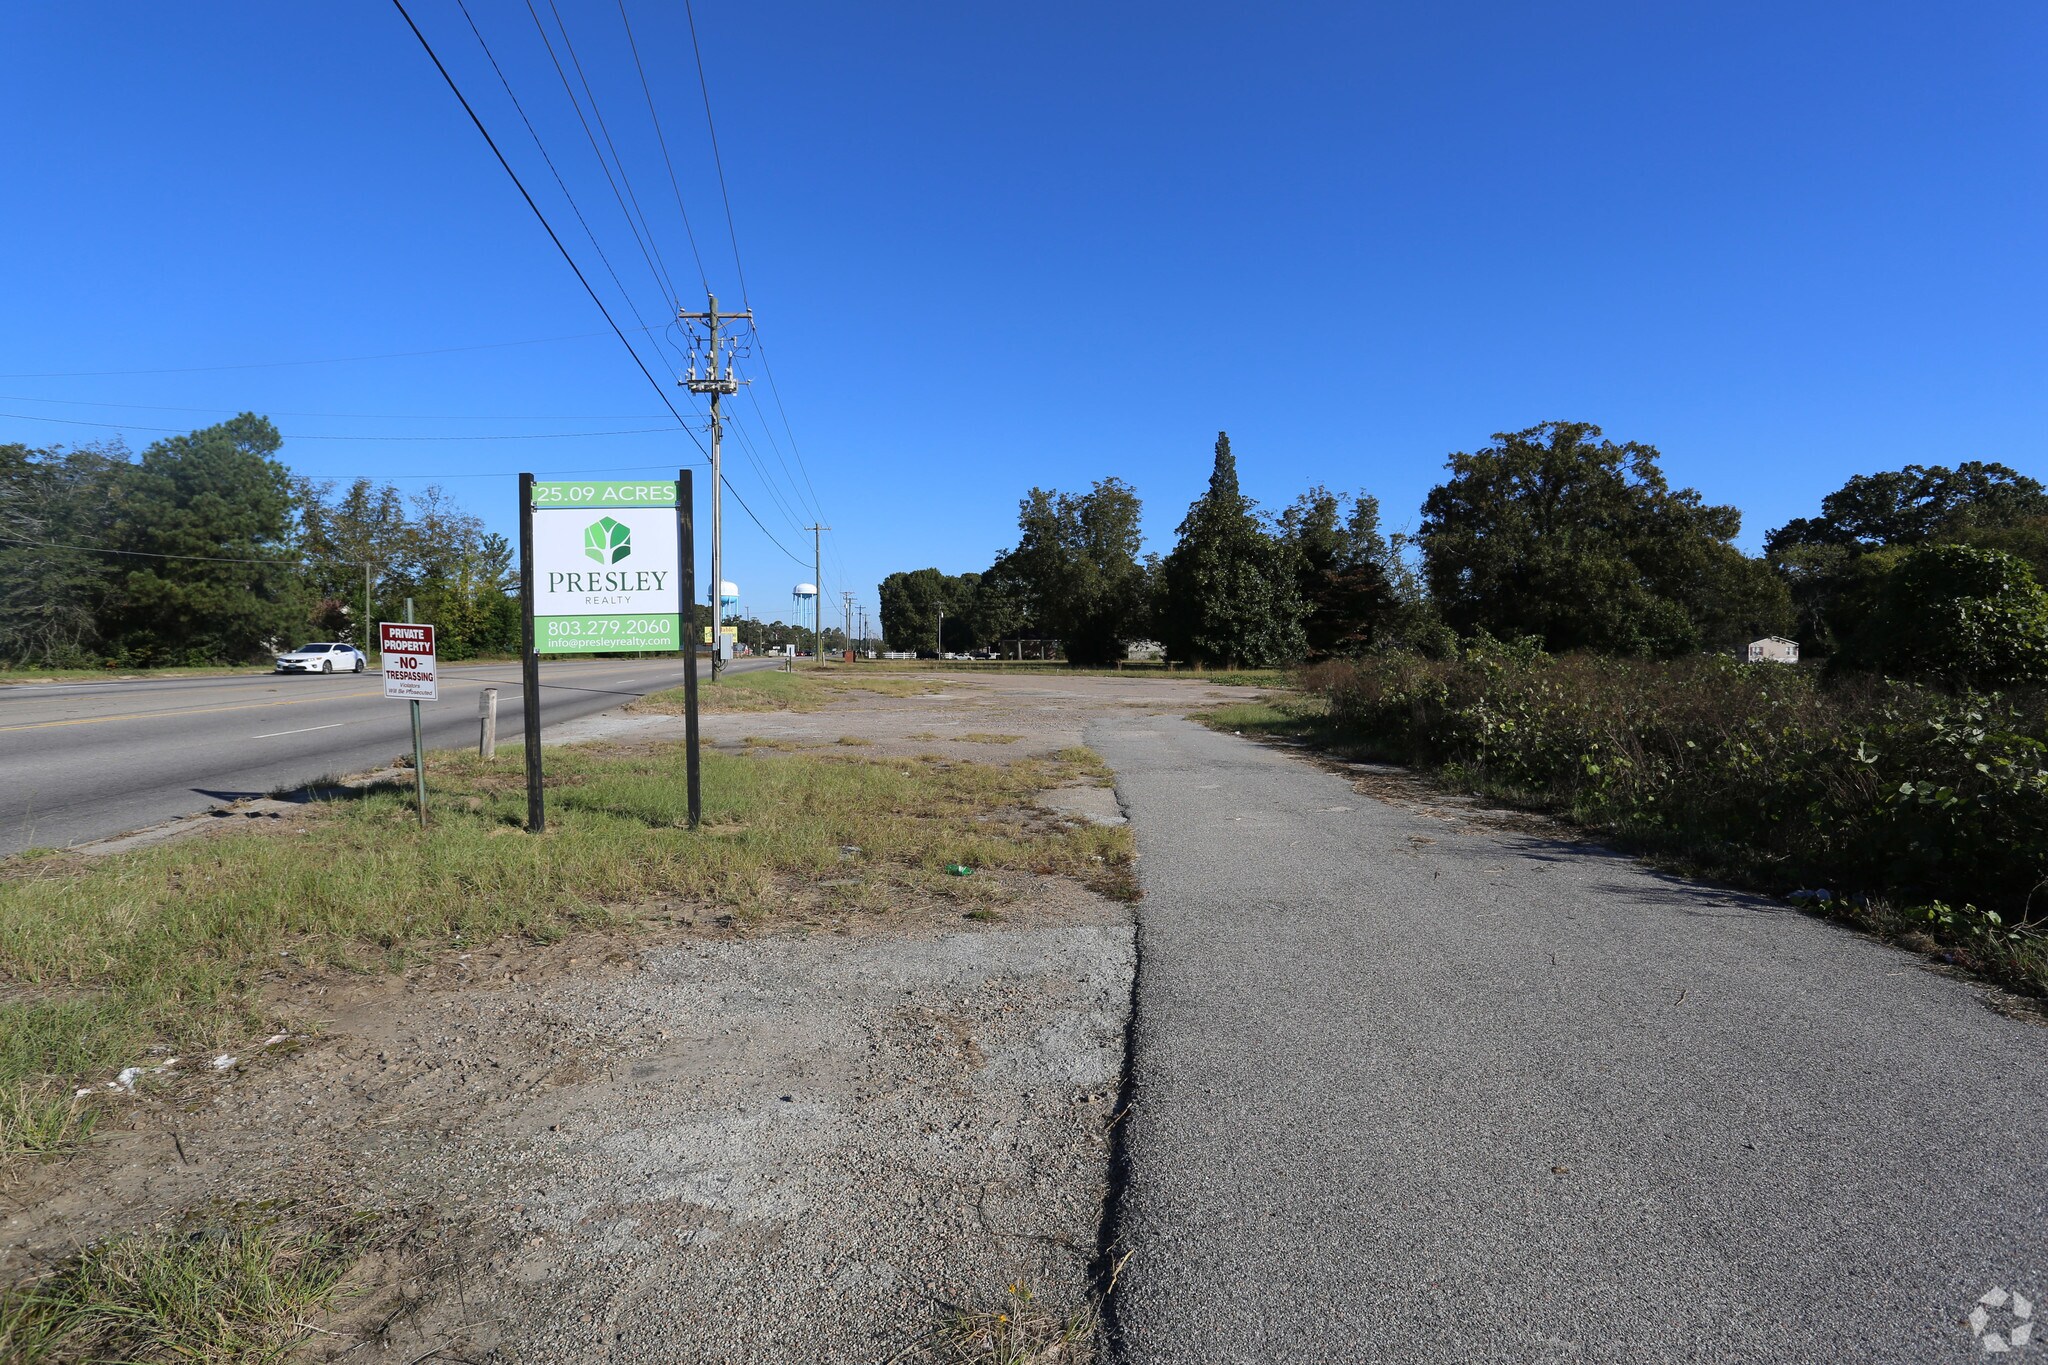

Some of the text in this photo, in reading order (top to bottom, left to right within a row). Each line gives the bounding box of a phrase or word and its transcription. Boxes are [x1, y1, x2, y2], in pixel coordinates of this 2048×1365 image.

[537, 485, 675, 502] 25.09 ACRES
[548, 571, 668, 593] PRESLEY
[585, 595, 632, 605] REALTY
[548, 619, 670, 636] 803.279.2060
[389, 628, 424, 639] PRIVATE
[384, 640, 430, 651] PROPERTY
[548, 637, 671, 649] info@presleyrealty.com
[386, 670, 433, 681] TRESPASSING
